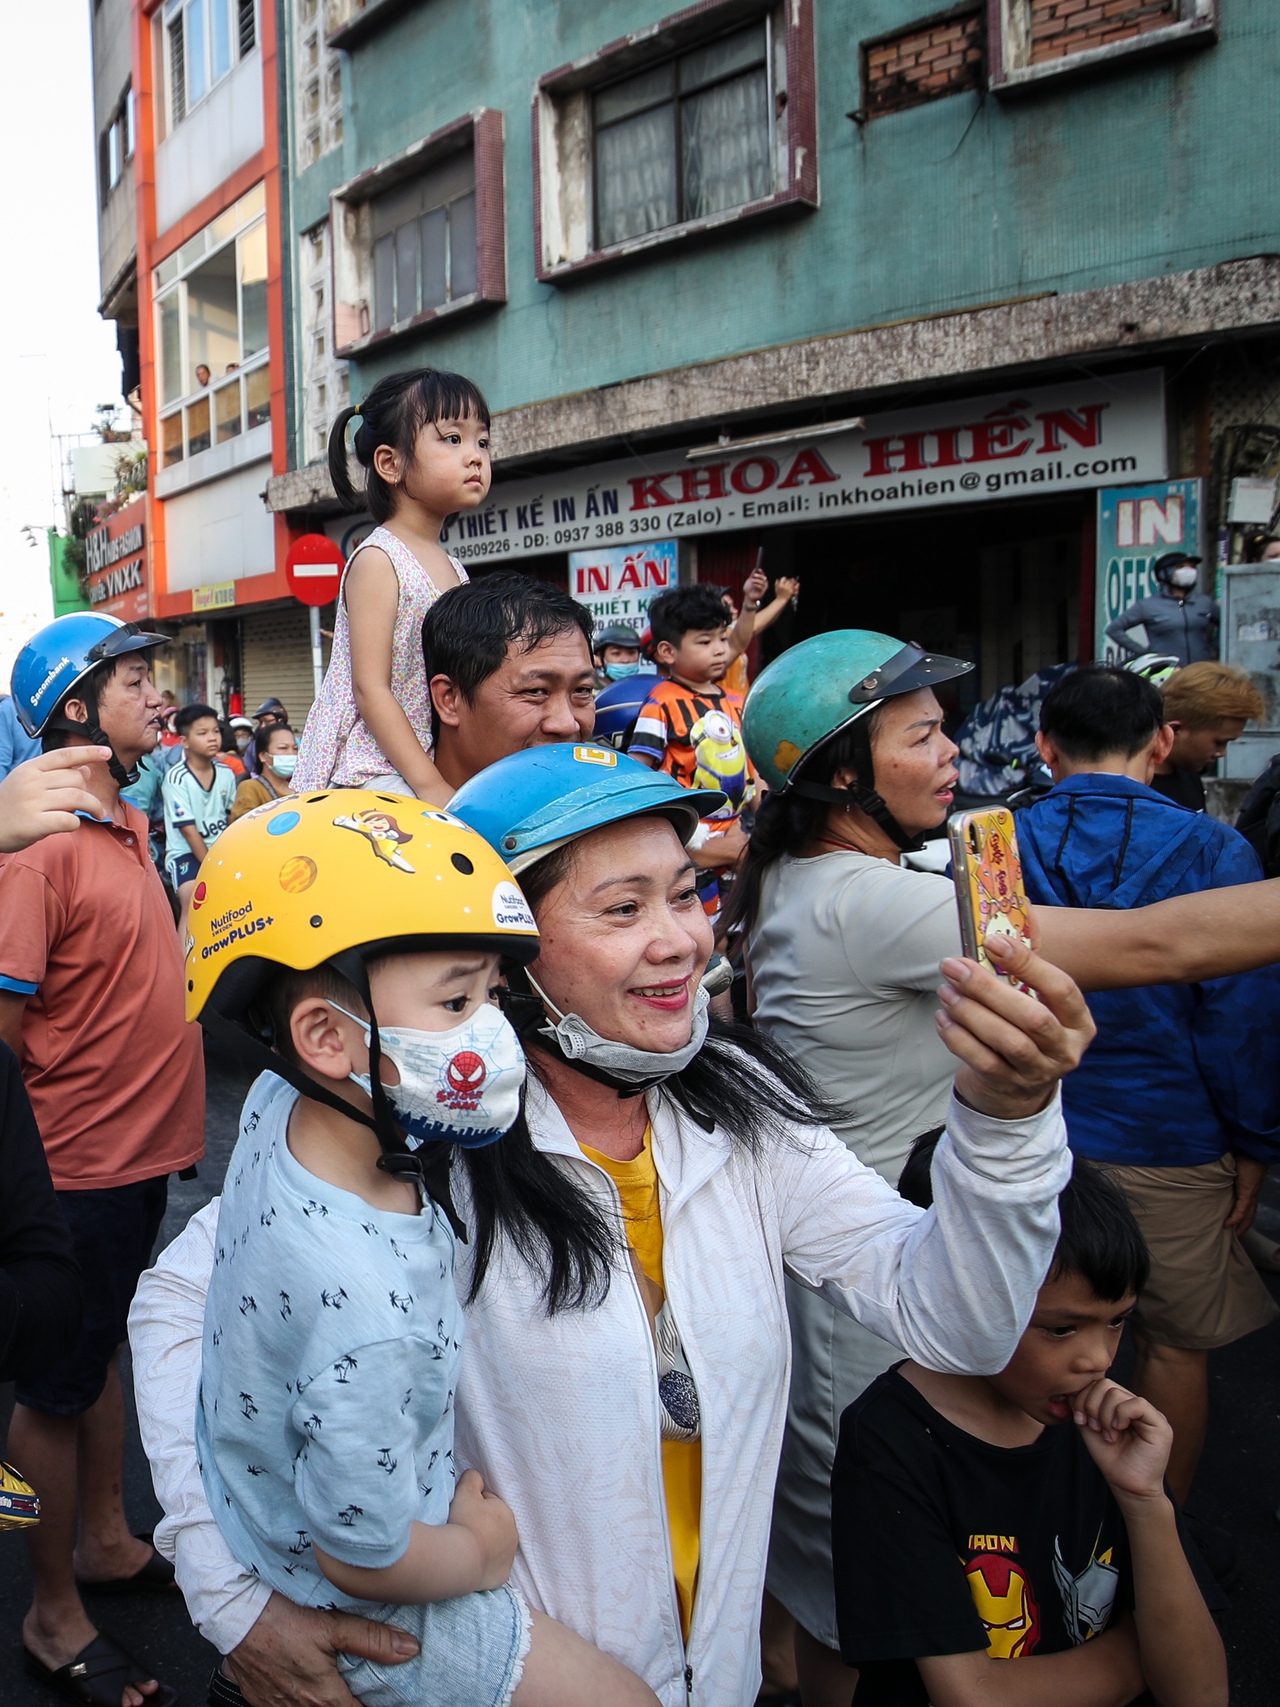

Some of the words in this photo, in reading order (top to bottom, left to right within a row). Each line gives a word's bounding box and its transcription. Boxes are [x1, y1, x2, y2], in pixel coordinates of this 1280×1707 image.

[627, 447, 841, 512] KHOA
[453, 538, 511, 560] 39509226
[554, 526, 590, 544] 0937
[595, 521, 624, 538] 388
[630, 515, 661, 534] 330
[667, 506, 722, 531] (Zalo)
[743, 494, 810, 519] Email:
[818, 454, 1137, 509] inkhoahien@gmail.com
[457, 503, 509, 540] THIẾT
[517, 495, 544, 530] KẾ
[553, 496, 576, 523] IN
[585, 484, 619, 519] ẤN
[1116, 495, 1184, 548] IN
[85, 526, 109, 575] H&H
[576, 564, 612, 595] IN
[617, 550, 670, 592] ẤN
[106, 559, 144, 597] VNXK
[30, 656, 70, 707] Sacombank
[200, 819, 227, 838] Jee
[201, 916, 274, 960] GrowPLUS+
[210, 901, 253, 931] Nutifood
[212, 923, 233, 937] SWEDEN
[968, 1533, 1020, 1555] IRON
